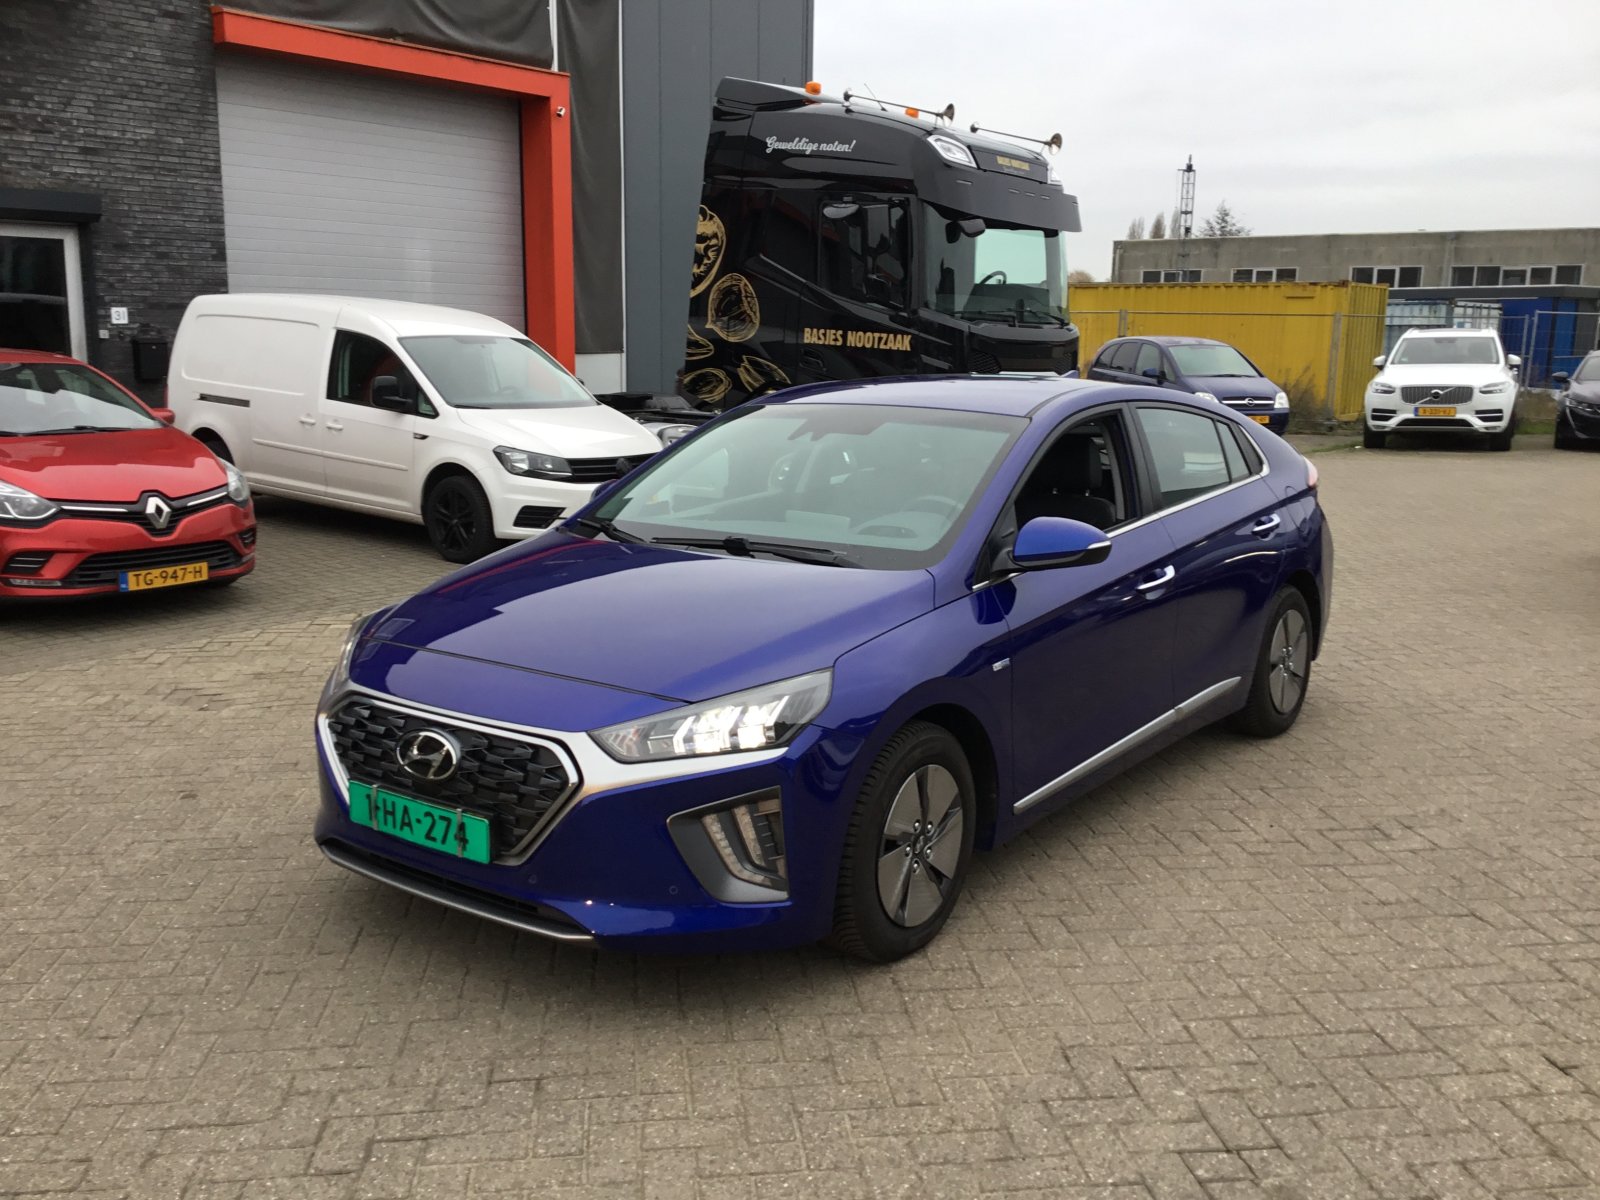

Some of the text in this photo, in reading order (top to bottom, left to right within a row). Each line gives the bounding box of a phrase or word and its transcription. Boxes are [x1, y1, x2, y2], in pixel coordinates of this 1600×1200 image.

[765, 136, 857, 155] Geweldige noten!
[803, 327, 912, 351] BASJES NOOTZAAK
[133, 565, 203, 587] TG-947-H
